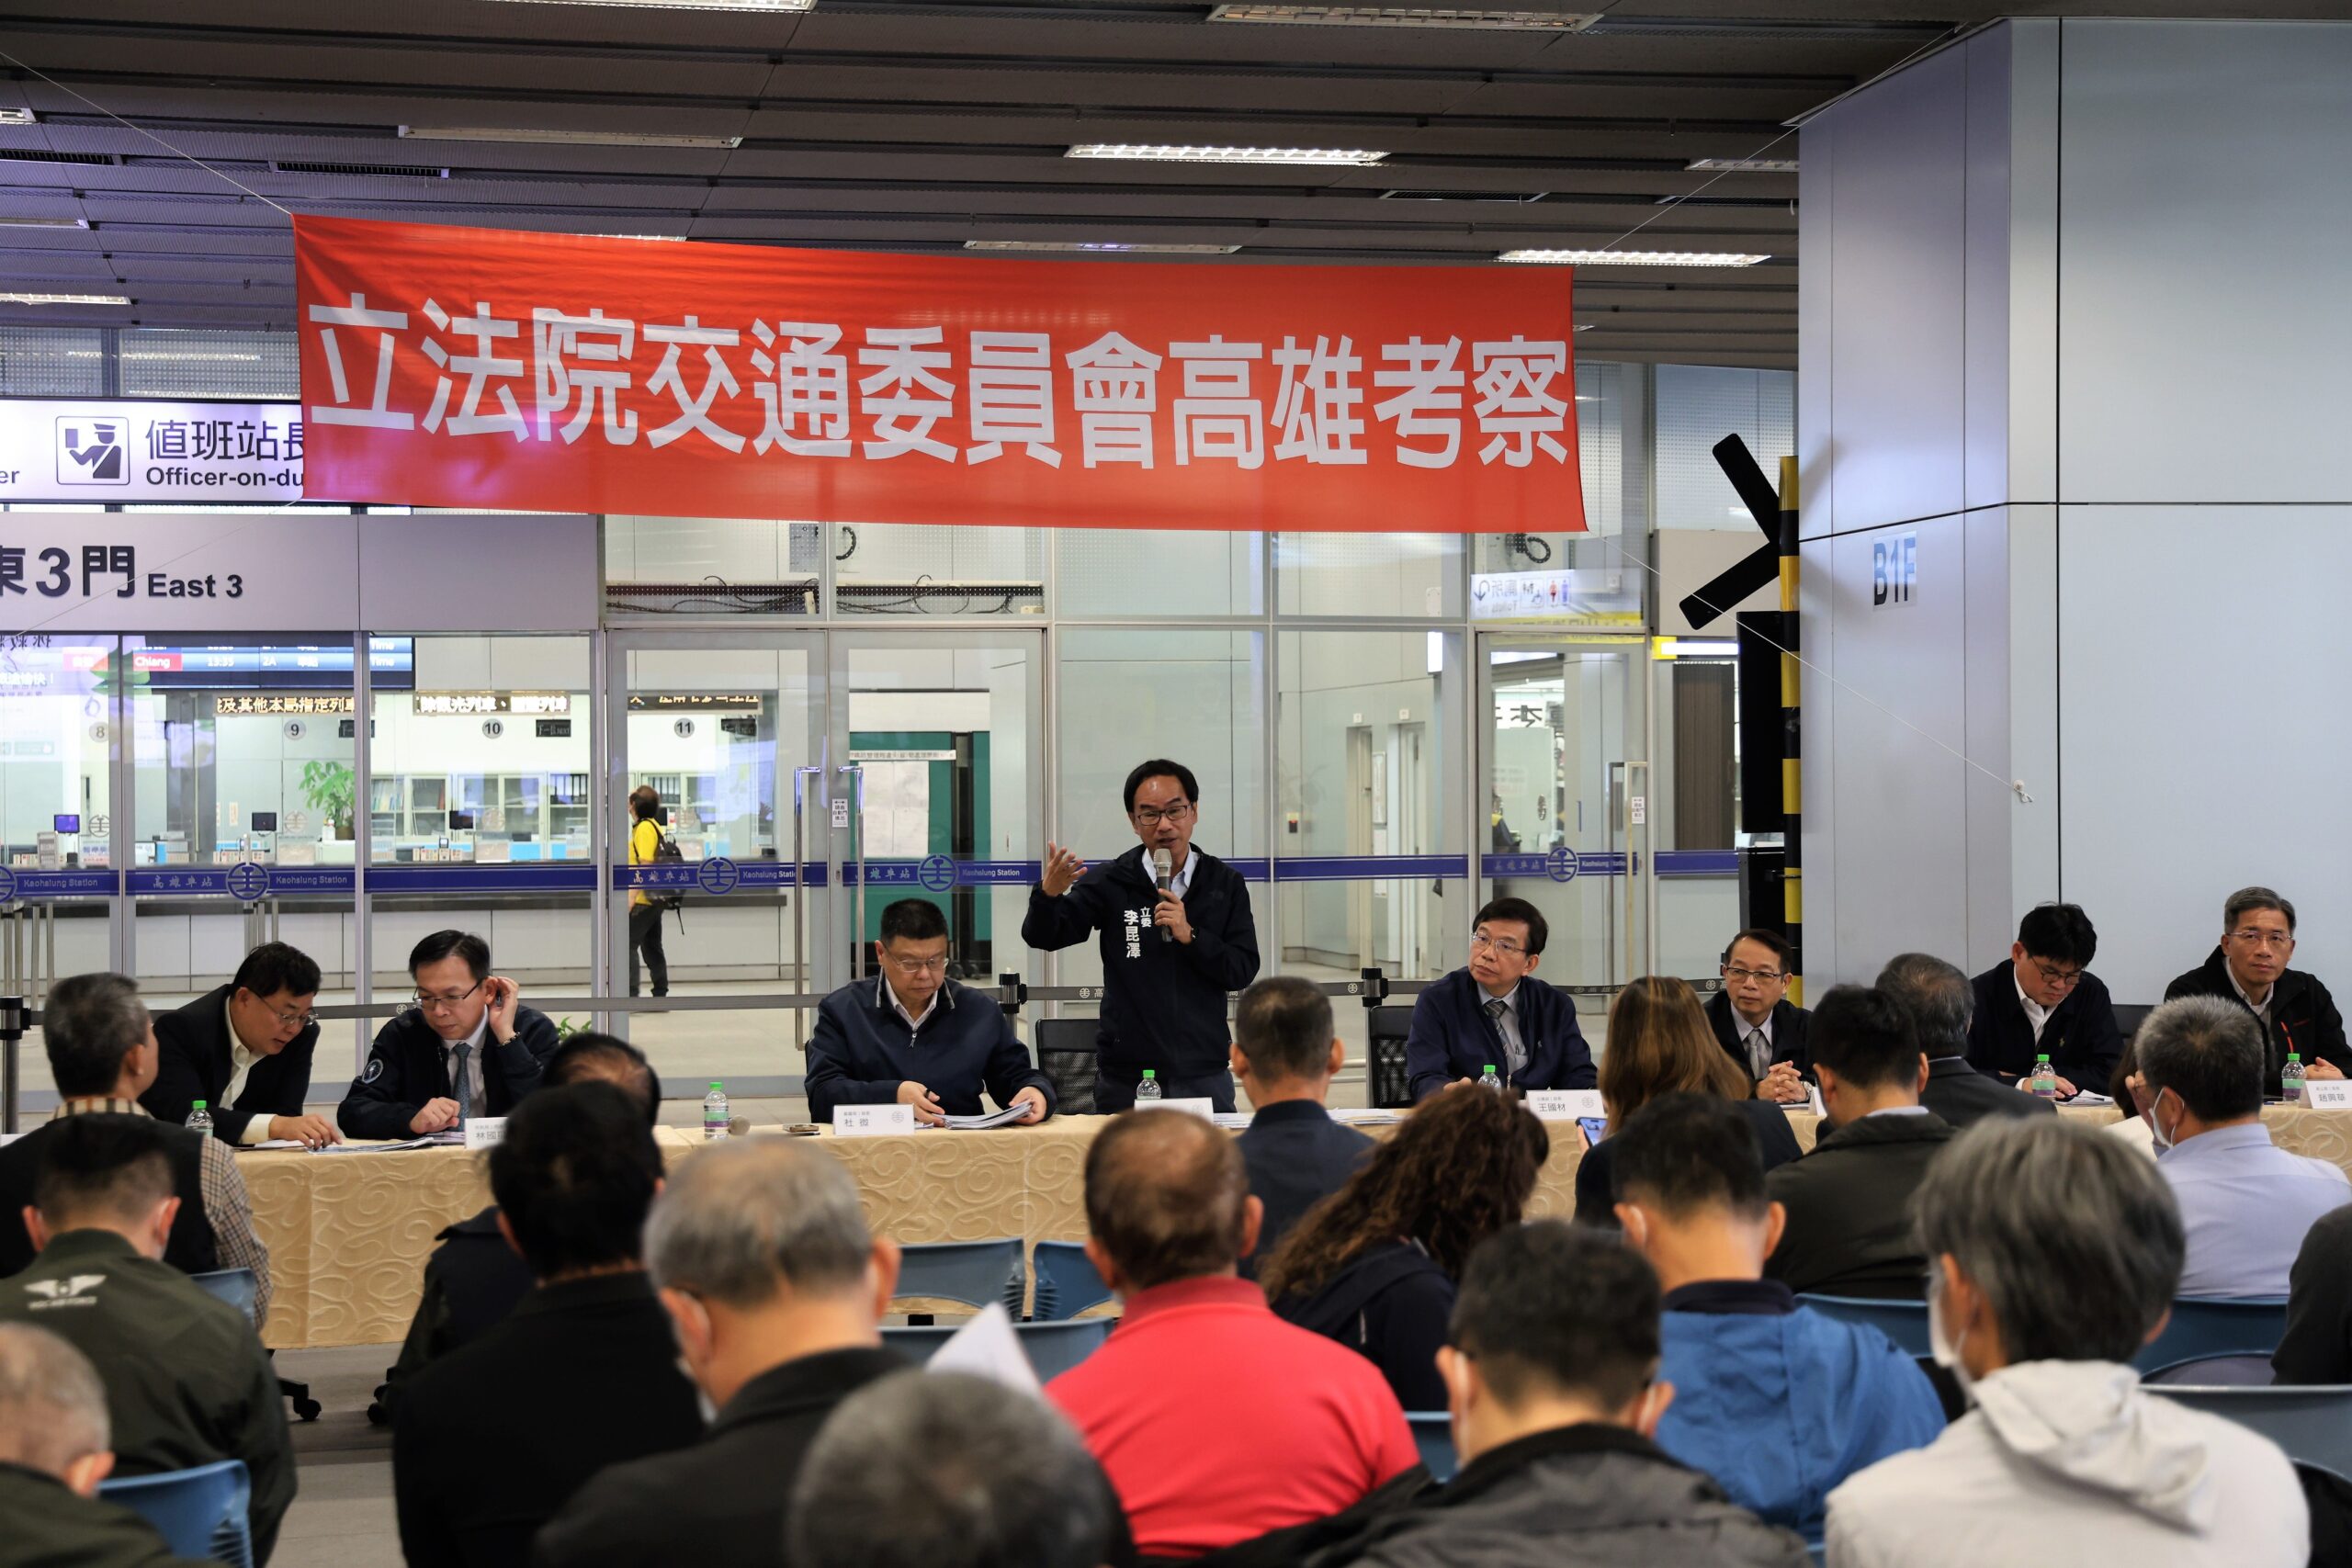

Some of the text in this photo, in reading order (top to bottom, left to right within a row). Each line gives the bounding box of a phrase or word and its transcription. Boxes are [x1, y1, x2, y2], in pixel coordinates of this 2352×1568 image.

[309, 292, 1569, 470] 立法院交通委員會高雄考察
[1873, 536, 1917, 606] B1F
[147, 573, 243, 598] East 3
[134, 656, 171, 669] Chiang
[96, 726, 105, 739] 8
[290, 723, 300, 737] 9
[485, 722, 501, 735] 10
[676, 720, 692, 734] 11
[997, 868, 1020, 876] Station
[24, 878, 98, 888] Kaohsiung Station
[153, 875, 213, 889] 高雄車站
[276, 875, 347, 885] Kaohsiung Station
[1140, 906, 1151, 928] 立委
[1124, 909, 1141, 959] 李昆澤
